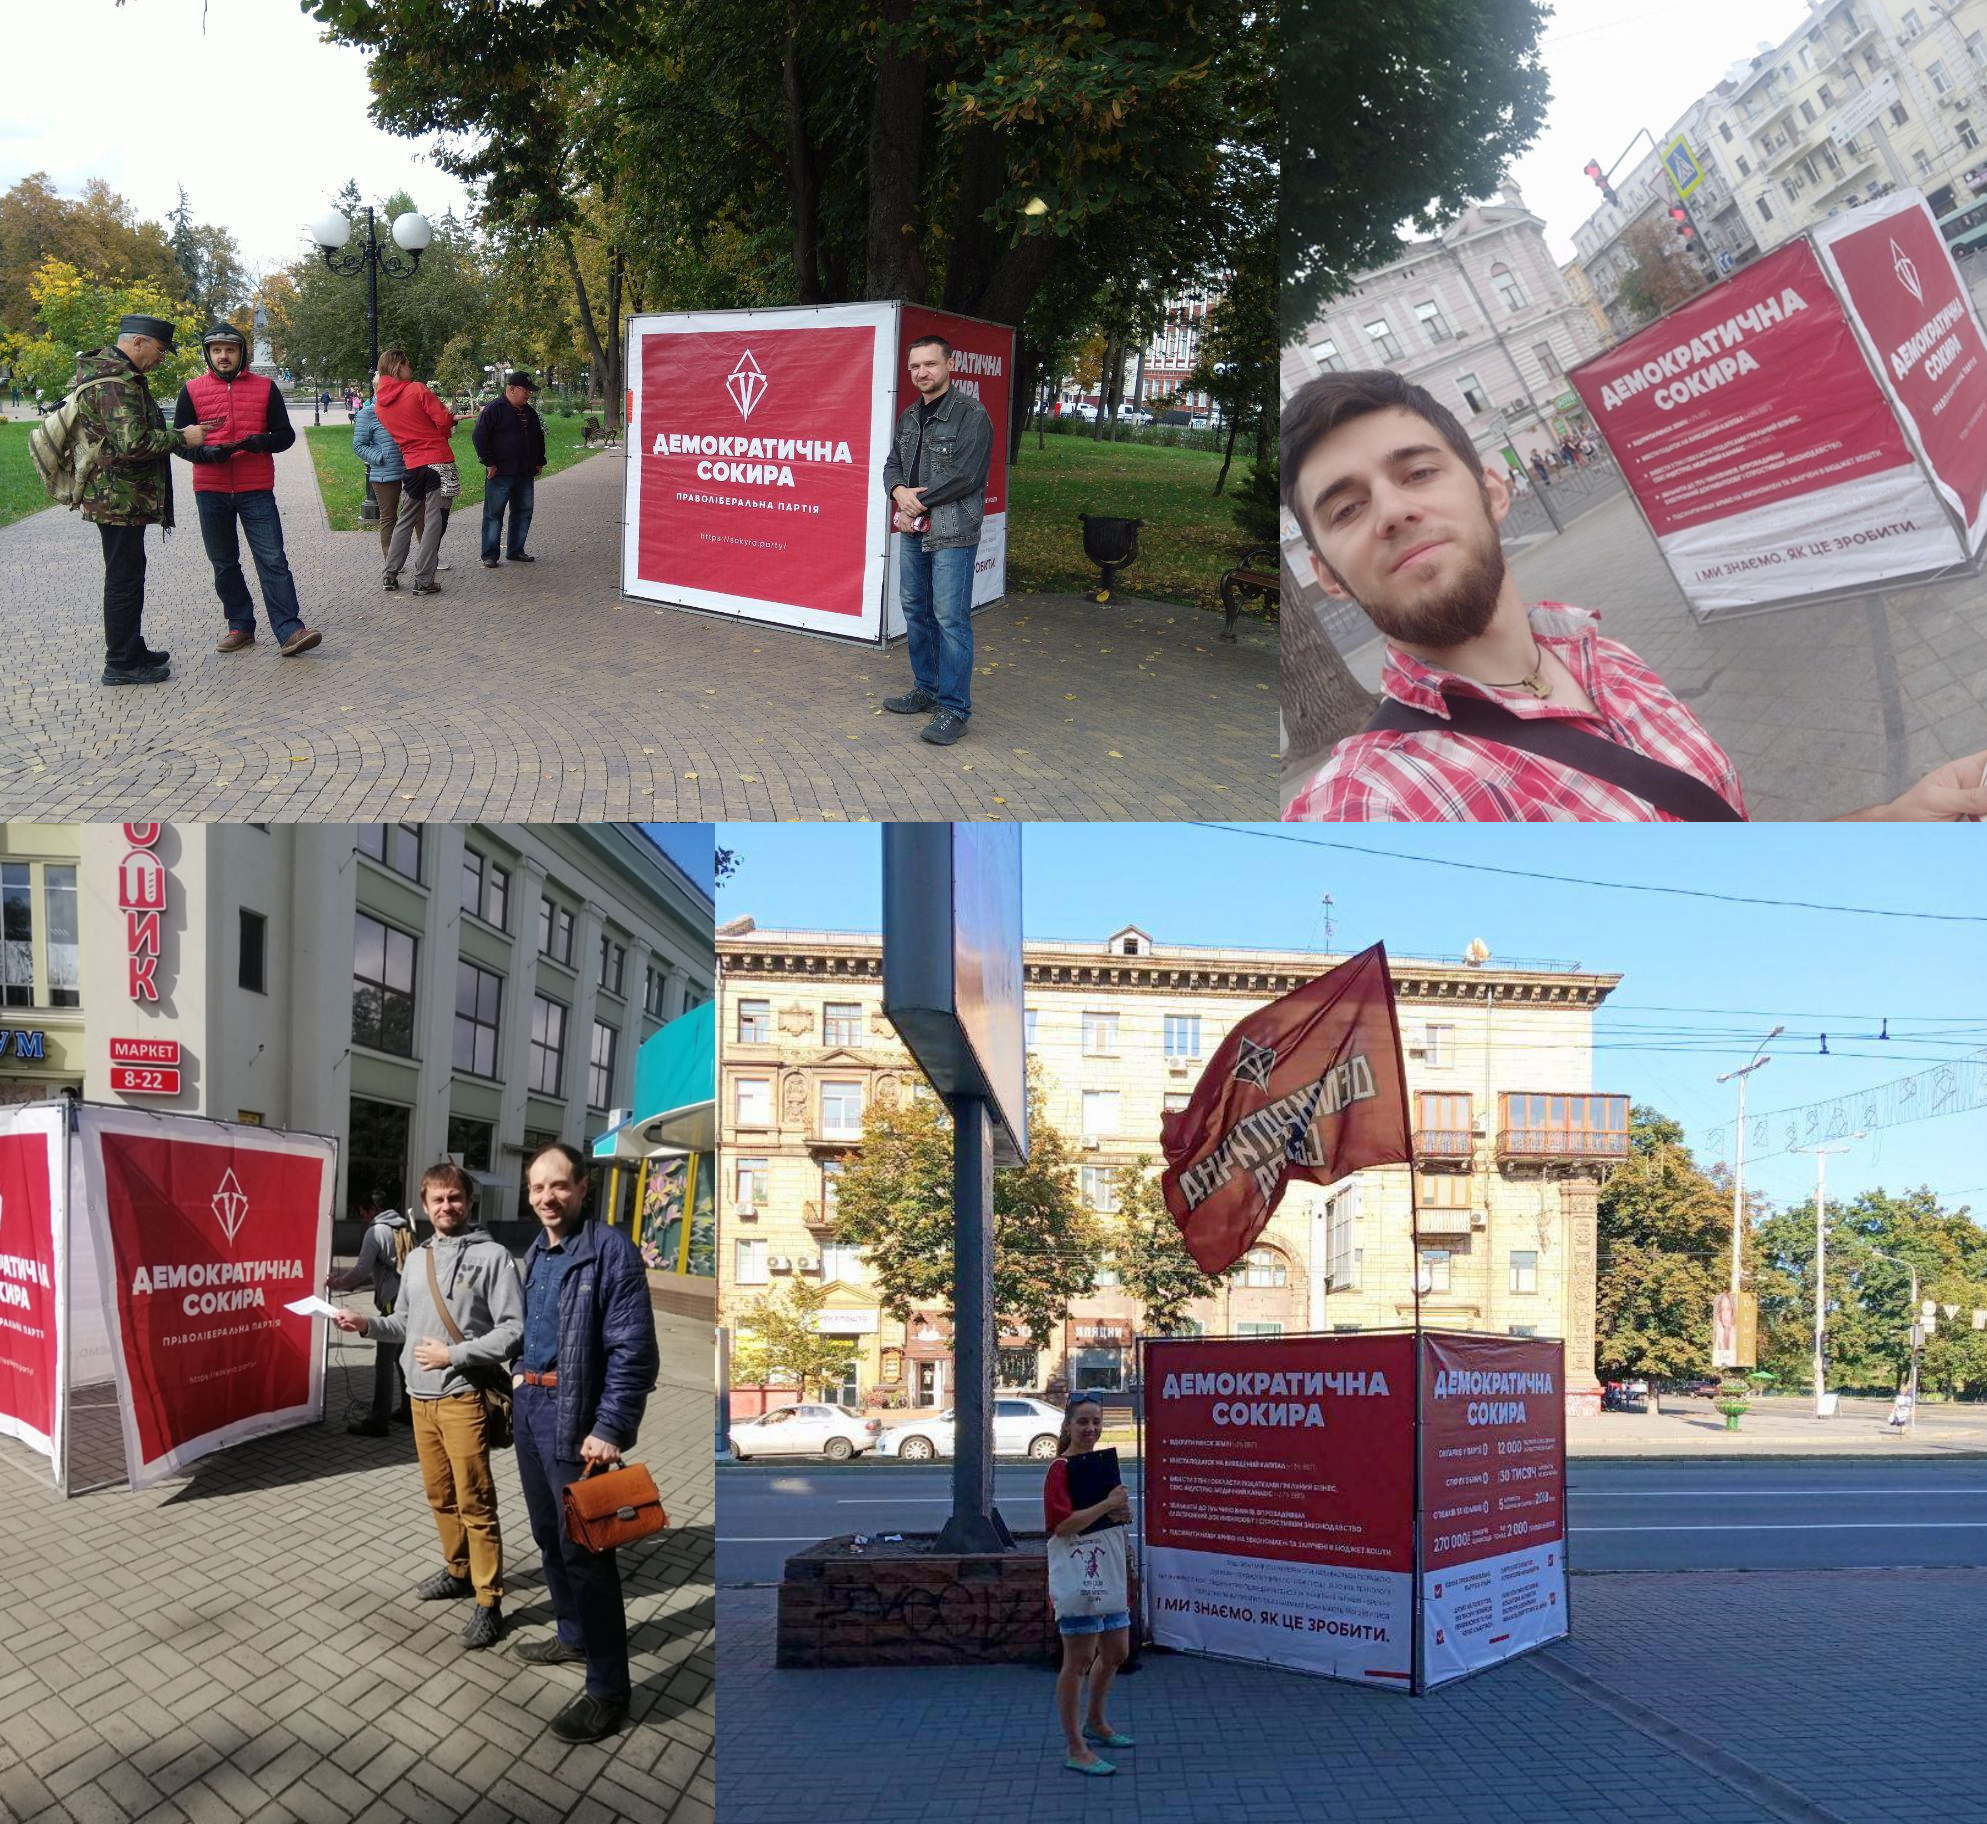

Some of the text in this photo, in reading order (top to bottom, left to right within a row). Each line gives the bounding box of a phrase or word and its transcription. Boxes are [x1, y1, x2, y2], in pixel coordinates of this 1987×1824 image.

[1600, 287, 1808, 411] ДЕМОКРАТИЧНА
[1890, 297, 1965, 381] ДЕМОКРАТИЧНА
[1924, 333, 1963, 381] СОКИРА
[1654, 349, 1760, 410] СОКИРА
[652, 433, 853, 463] ДЕМОКРАТИЧНА
[697, 461, 795, 487] СОКИРА
[676, 492, 820, 514] ПРАВОЛІБЕРАЛЬНА ПАРТІЯ
[700, 532, 787, 550] https://sokyra.party/
[1702, 563, 1723, 582] МИ
[1725, 552, 1786, 577] ЗНАЄМО,
[1787, 546, 1807, 561] ЯК
[1810, 540, 1833, 558] ЦЕ
[1835, 519, 1921, 552] ЗРОБИТИ.
[115, 1042, 174, 1059] МАРКЕТ
[124, 1071, 163, 1089] 8-22
[132, 1259, 304, 1296] ДЕМОКРАТИЧНА
[182, 1286, 265, 1316] СОКИРА
[252, 1319, 281, 1331] ПАРТІЯ
[1162, 1371, 1389, 1399] ДЕМОКРАТИЧНА
[1434, 1370, 1553, 1399] ДЕМОКРАТИЧНА
[1212, 1402, 1325, 1428] СОКИРА
[1467, 1401, 1526, 1425] СОКИРА
[1165, 1599, 1190, 1613] МИ
[1194, 1601, 1256, 1623] ЗНАЄМО,
[1260, 1612, 1278, 1627] ЯК
[1282, 1615, 1303, 1634] ЦЕ
[1308, 1618, 1390, 1643] ЗРОБИТИ.
